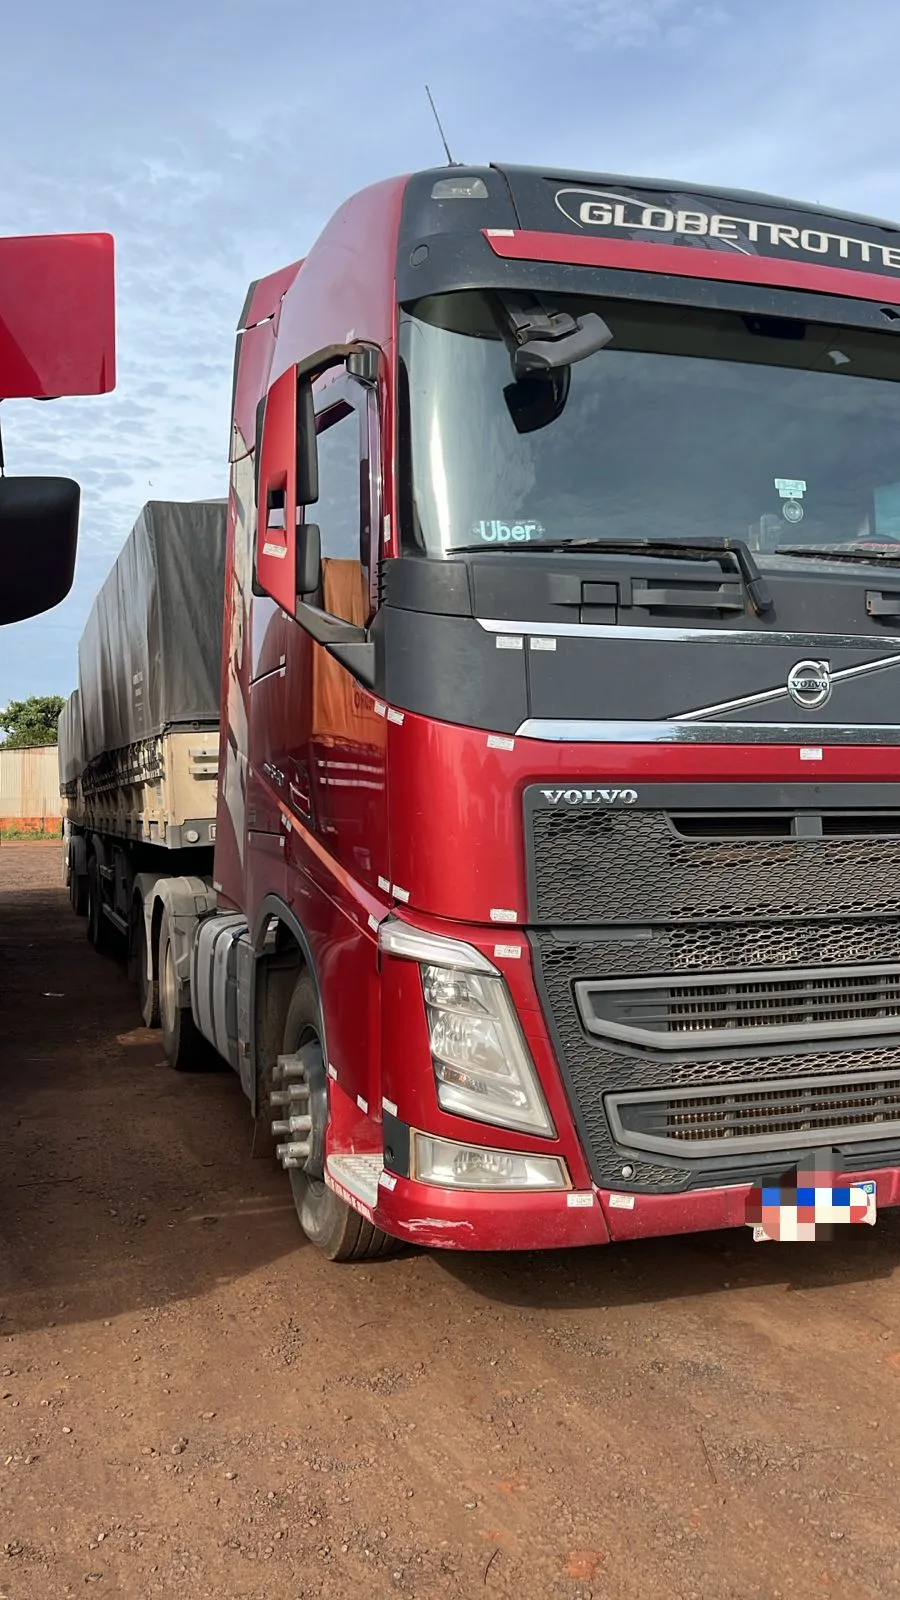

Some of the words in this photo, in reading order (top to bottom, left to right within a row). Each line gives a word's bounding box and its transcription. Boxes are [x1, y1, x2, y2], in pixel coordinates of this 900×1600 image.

[479, 520, 536, 541] Uber
[791, 680, 828, 689] VOLVO
[540, 789, 639, 805] VOLVO
